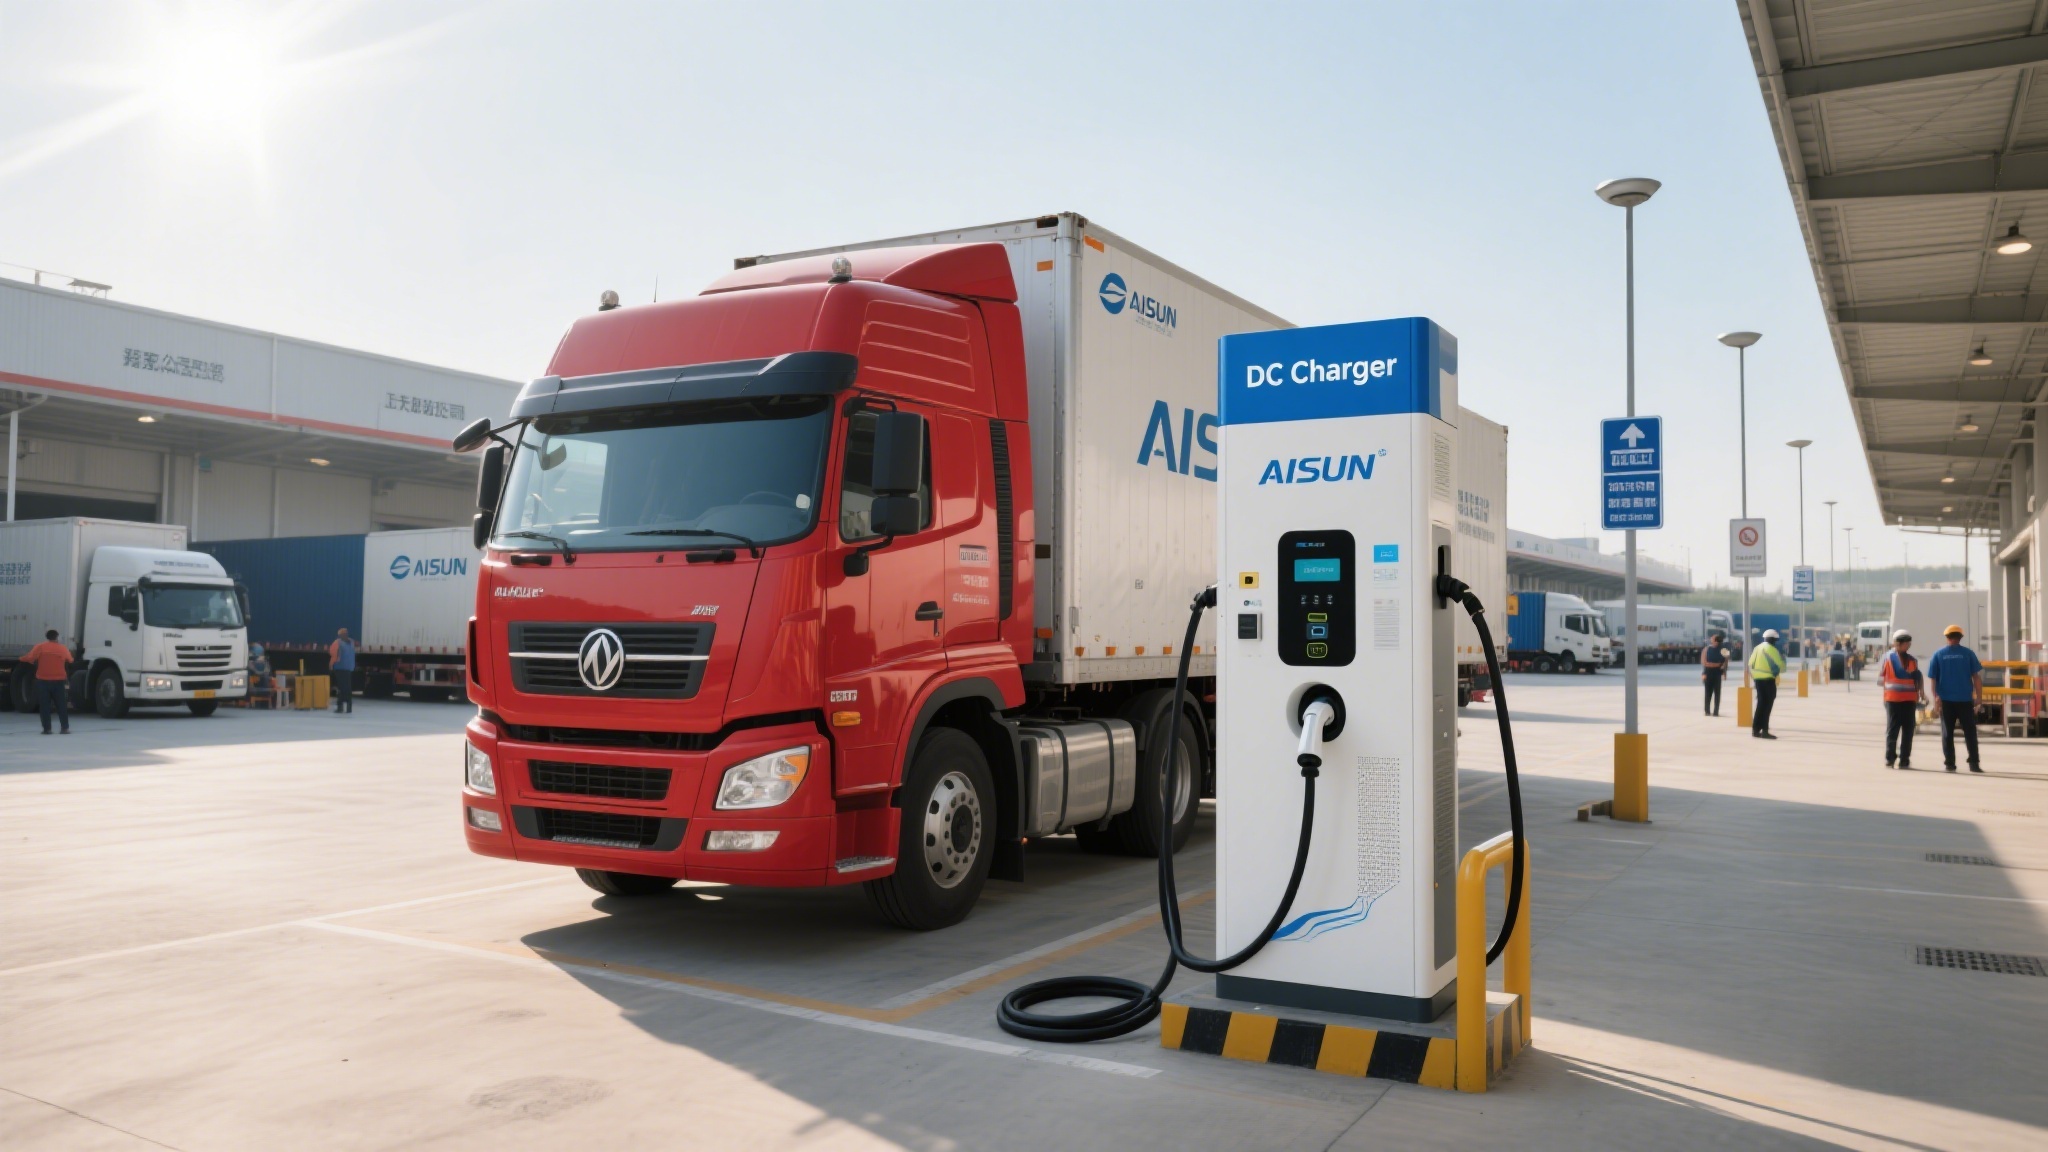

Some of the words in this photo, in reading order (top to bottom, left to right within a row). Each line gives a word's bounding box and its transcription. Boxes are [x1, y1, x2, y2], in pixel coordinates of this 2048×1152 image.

[1129, 291, 1177, 329] AISUN
[1247, 362, 1283, 388] DC
[1290, 358, 1397, 386] Charger
[1258, 454, 1376, 485] AISUN
[413, 557, 467, 576] AISUN
